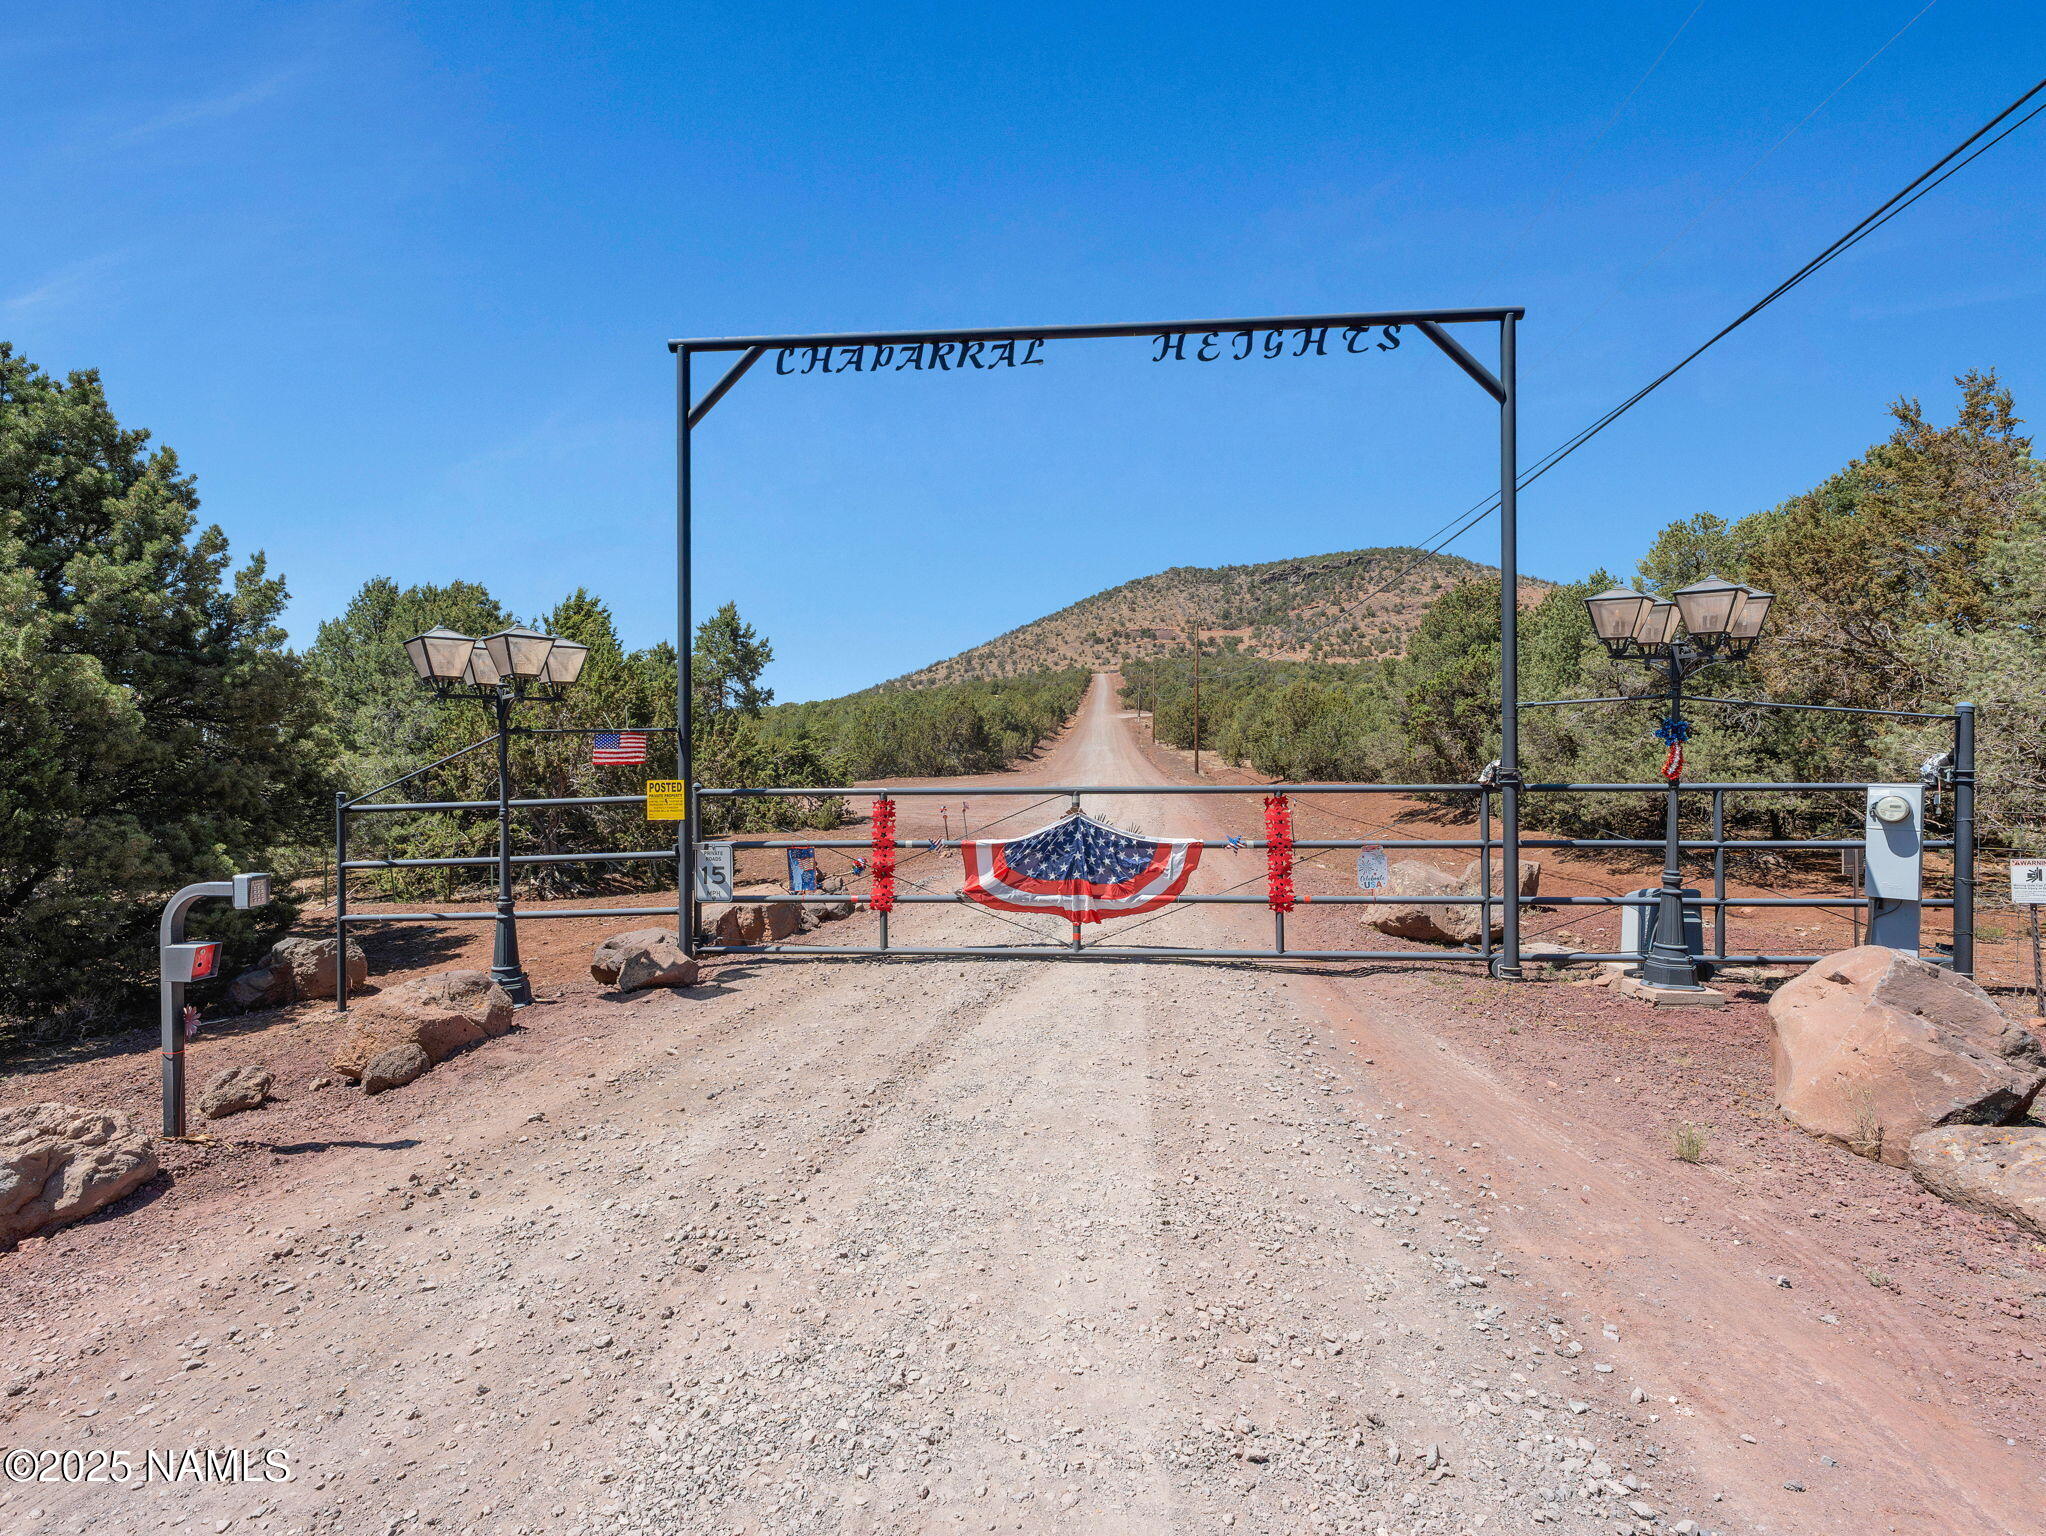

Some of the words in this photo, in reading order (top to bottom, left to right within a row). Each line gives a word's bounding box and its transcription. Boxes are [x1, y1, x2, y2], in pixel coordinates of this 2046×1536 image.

[776, 337, 1045, 375] CHAPARRAL
[1152, 324, 1402, 362] HEIGHTS
[649, 782, 682, 793] POSTED
[702, 866, 726, 884] 15
